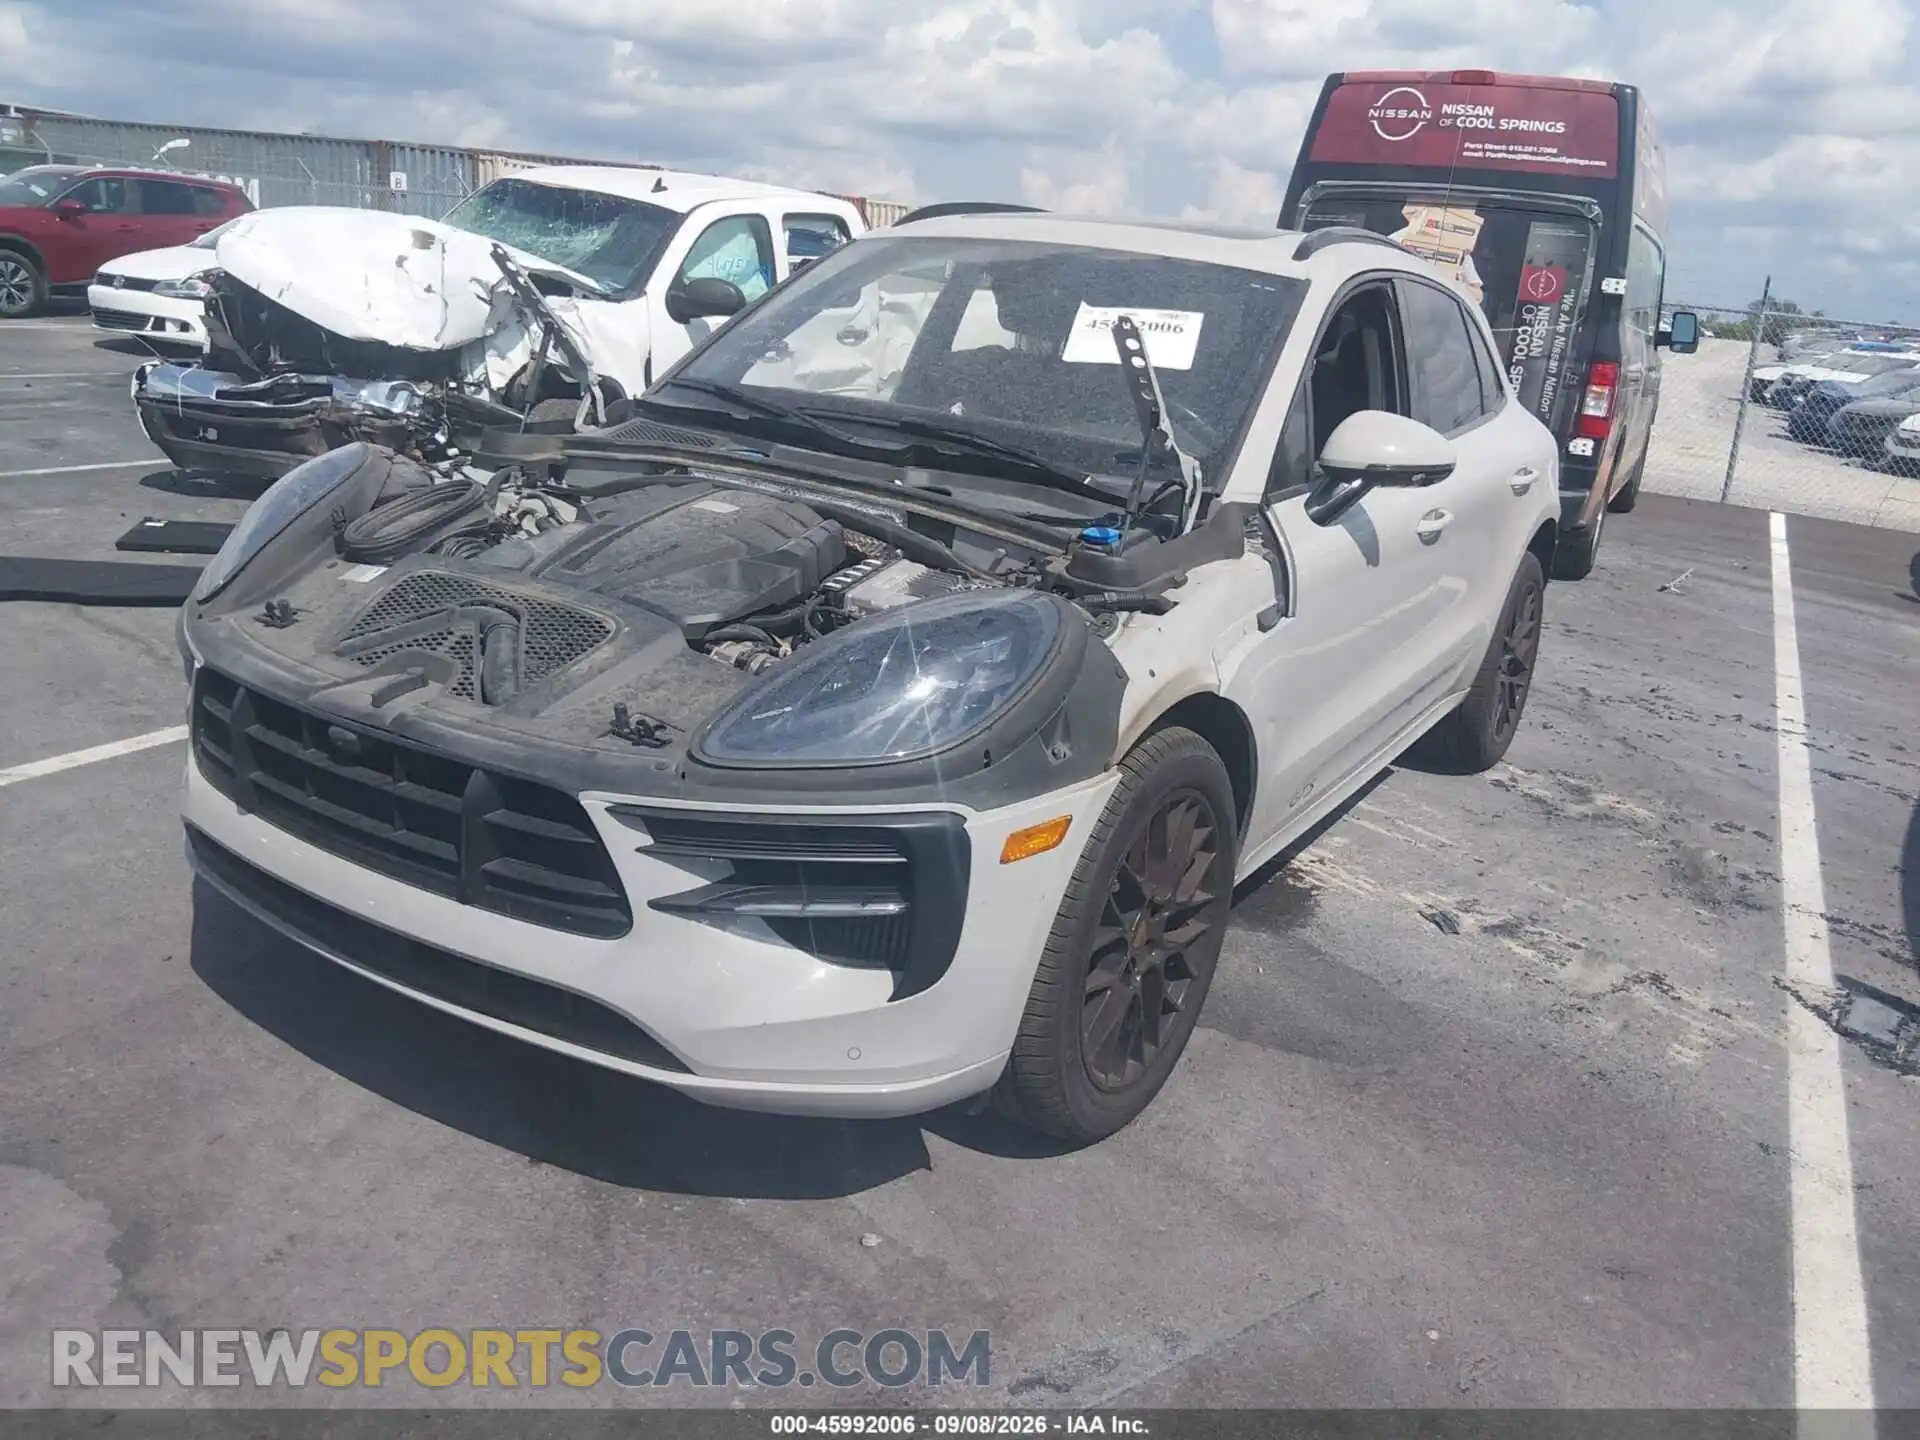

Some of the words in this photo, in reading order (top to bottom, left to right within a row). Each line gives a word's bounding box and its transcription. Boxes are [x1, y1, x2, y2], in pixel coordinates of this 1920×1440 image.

[1368, 108, 1432, 119] NISSAN
[1440, 103, 1494, 116] NISSAN
[1439, 118, 1453, 127] OF
[1456, 117, 1495, 129] COOL
[1499, 119, 1566, 133] SPRINGS
[1521, 304, 1537, 324] OF
[1556, 312, 1571, 333] Are
[1528, 305, 1551, 357] NISSAN
[1512, 325, 1532, 363] COOL
[1547, 335, 1567, 373] Nissan
